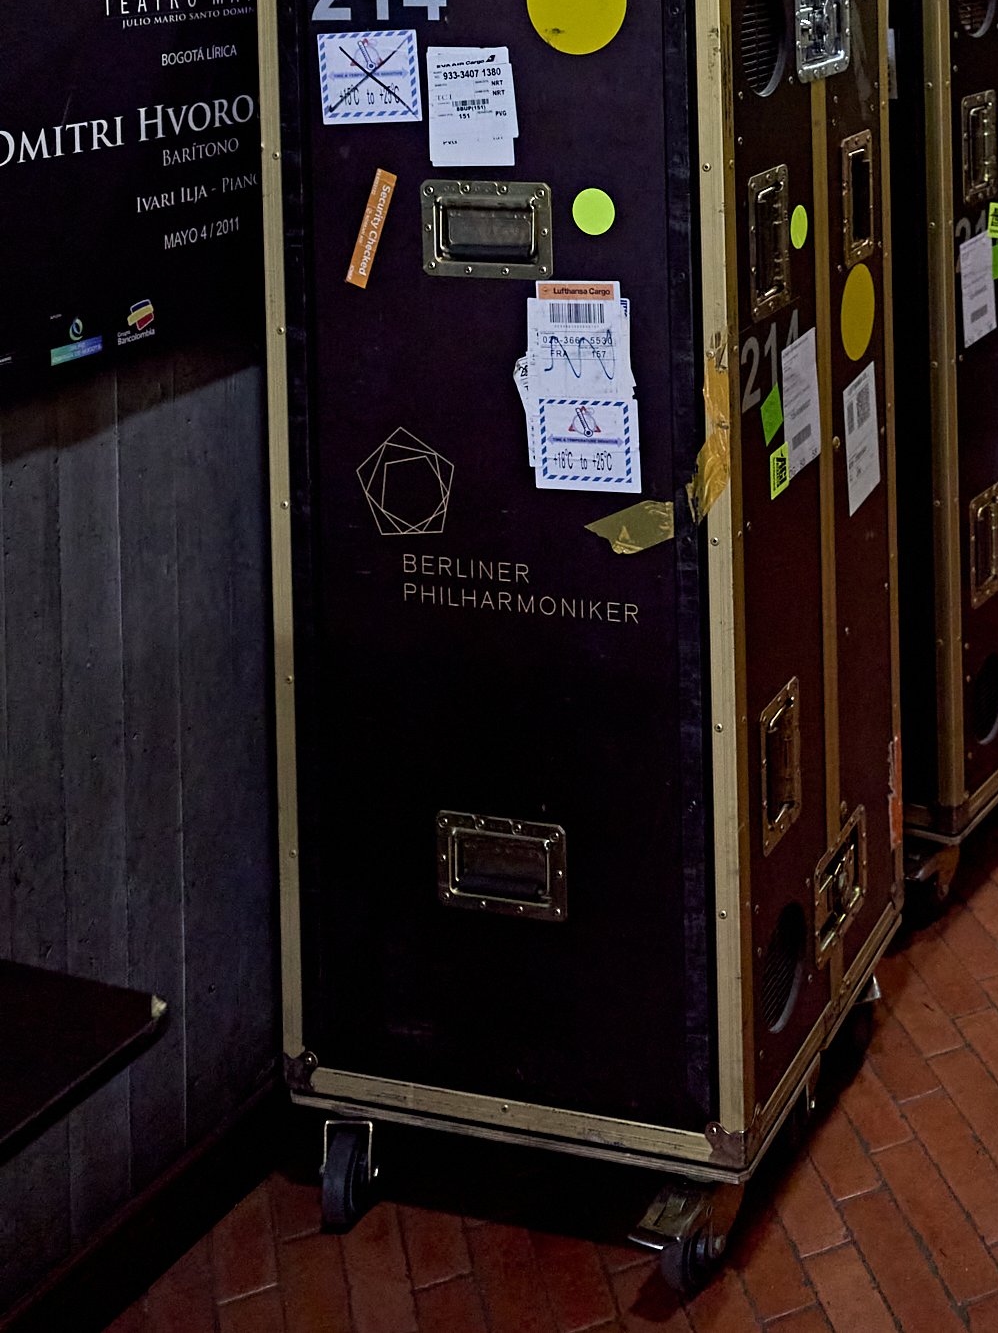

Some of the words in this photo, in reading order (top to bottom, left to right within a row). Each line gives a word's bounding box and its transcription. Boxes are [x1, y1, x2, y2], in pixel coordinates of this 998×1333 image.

[122, 16, 151, 29] JULIO
[153, 13, 187, 24] MARIO
[189, 9, 220, 21] SANTO
[161, 46, 205, 66] BOGOTÁ
[206, 44, 238, 60] LÍRICA
[443, 69, 479, 80] 933-3407
[482, 67, 502, 77] 1380
[366, 88, 375, 105] to
[162, 137, 239, 166] BARÍTONO
[136, 191, 175, 213] IVARI
[180, 185, 208, 204] ILJA
[371, 184, 391, 231] Security
[164, 227, 198, 250] MAYO
[200, 224, 207, 240] 4
[215, 215, 240, 237] 2011
[358, 230, 379, 277] Checked
[552, 287, 588, 295] Lufthansa
[588, 287, 611, 296] Cargo
[117, 328, 156, 346] Bancolombia
[550, 350, 568, 359] FRA
[579, 455, 588, 470] to
[592, 450, 613, 472] +25°C
[402, 553, 530, 585] BERLINER
[402, 583, 640, 625] PHILHARMONIKER
